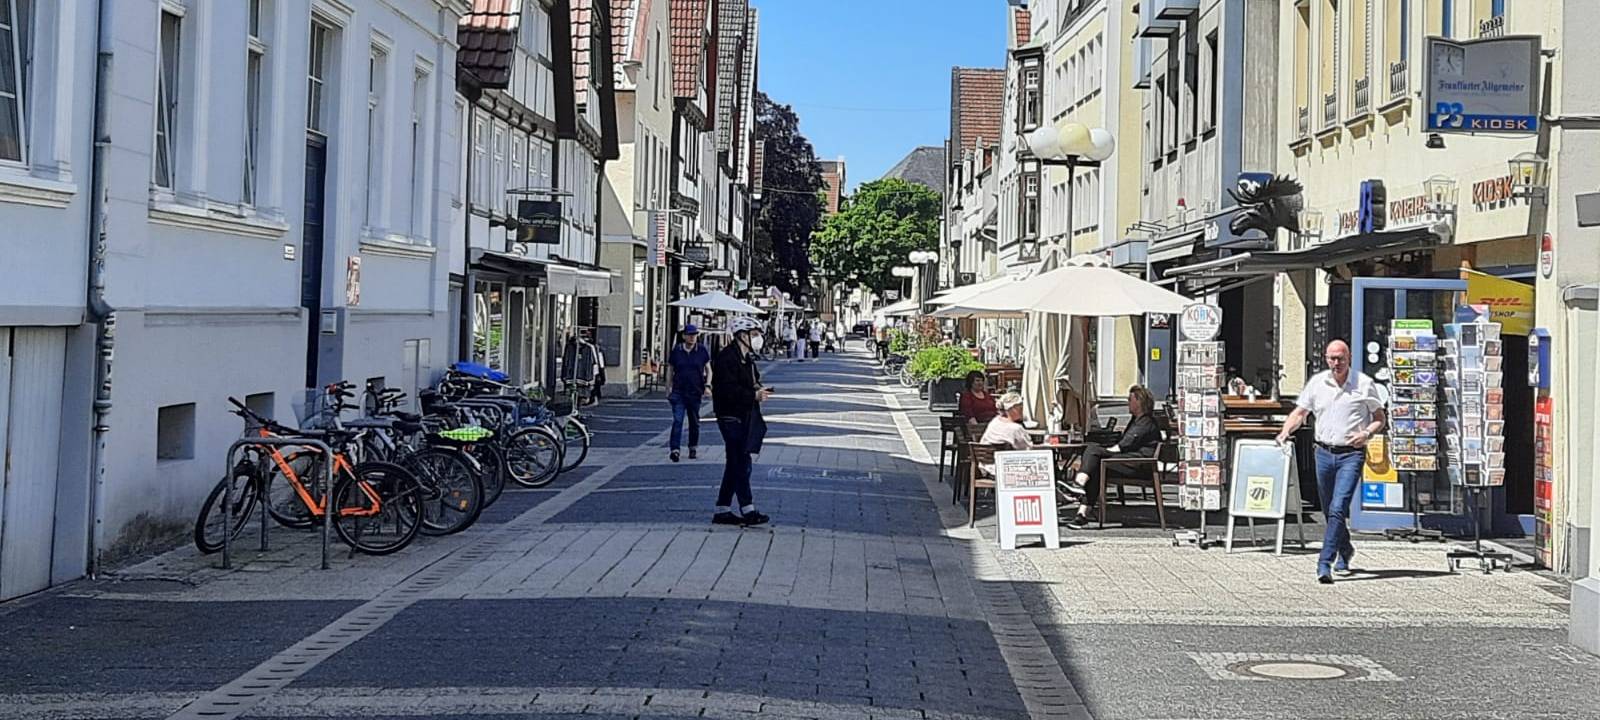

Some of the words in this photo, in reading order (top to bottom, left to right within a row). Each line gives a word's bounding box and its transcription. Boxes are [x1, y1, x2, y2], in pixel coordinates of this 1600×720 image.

[1438, 80, 1480, 92] Frankfurter
[1481, 80, 1525, 93] Allgemeine
[1436, 102, 1464, 127] P3
[1471, 119, 1528, 130] KIOSK
[1473, 176, 1513, 205] KIOSK
[1480, 298, 1521, 306] DHL
[1016, 499, 1039, 522] Bild
